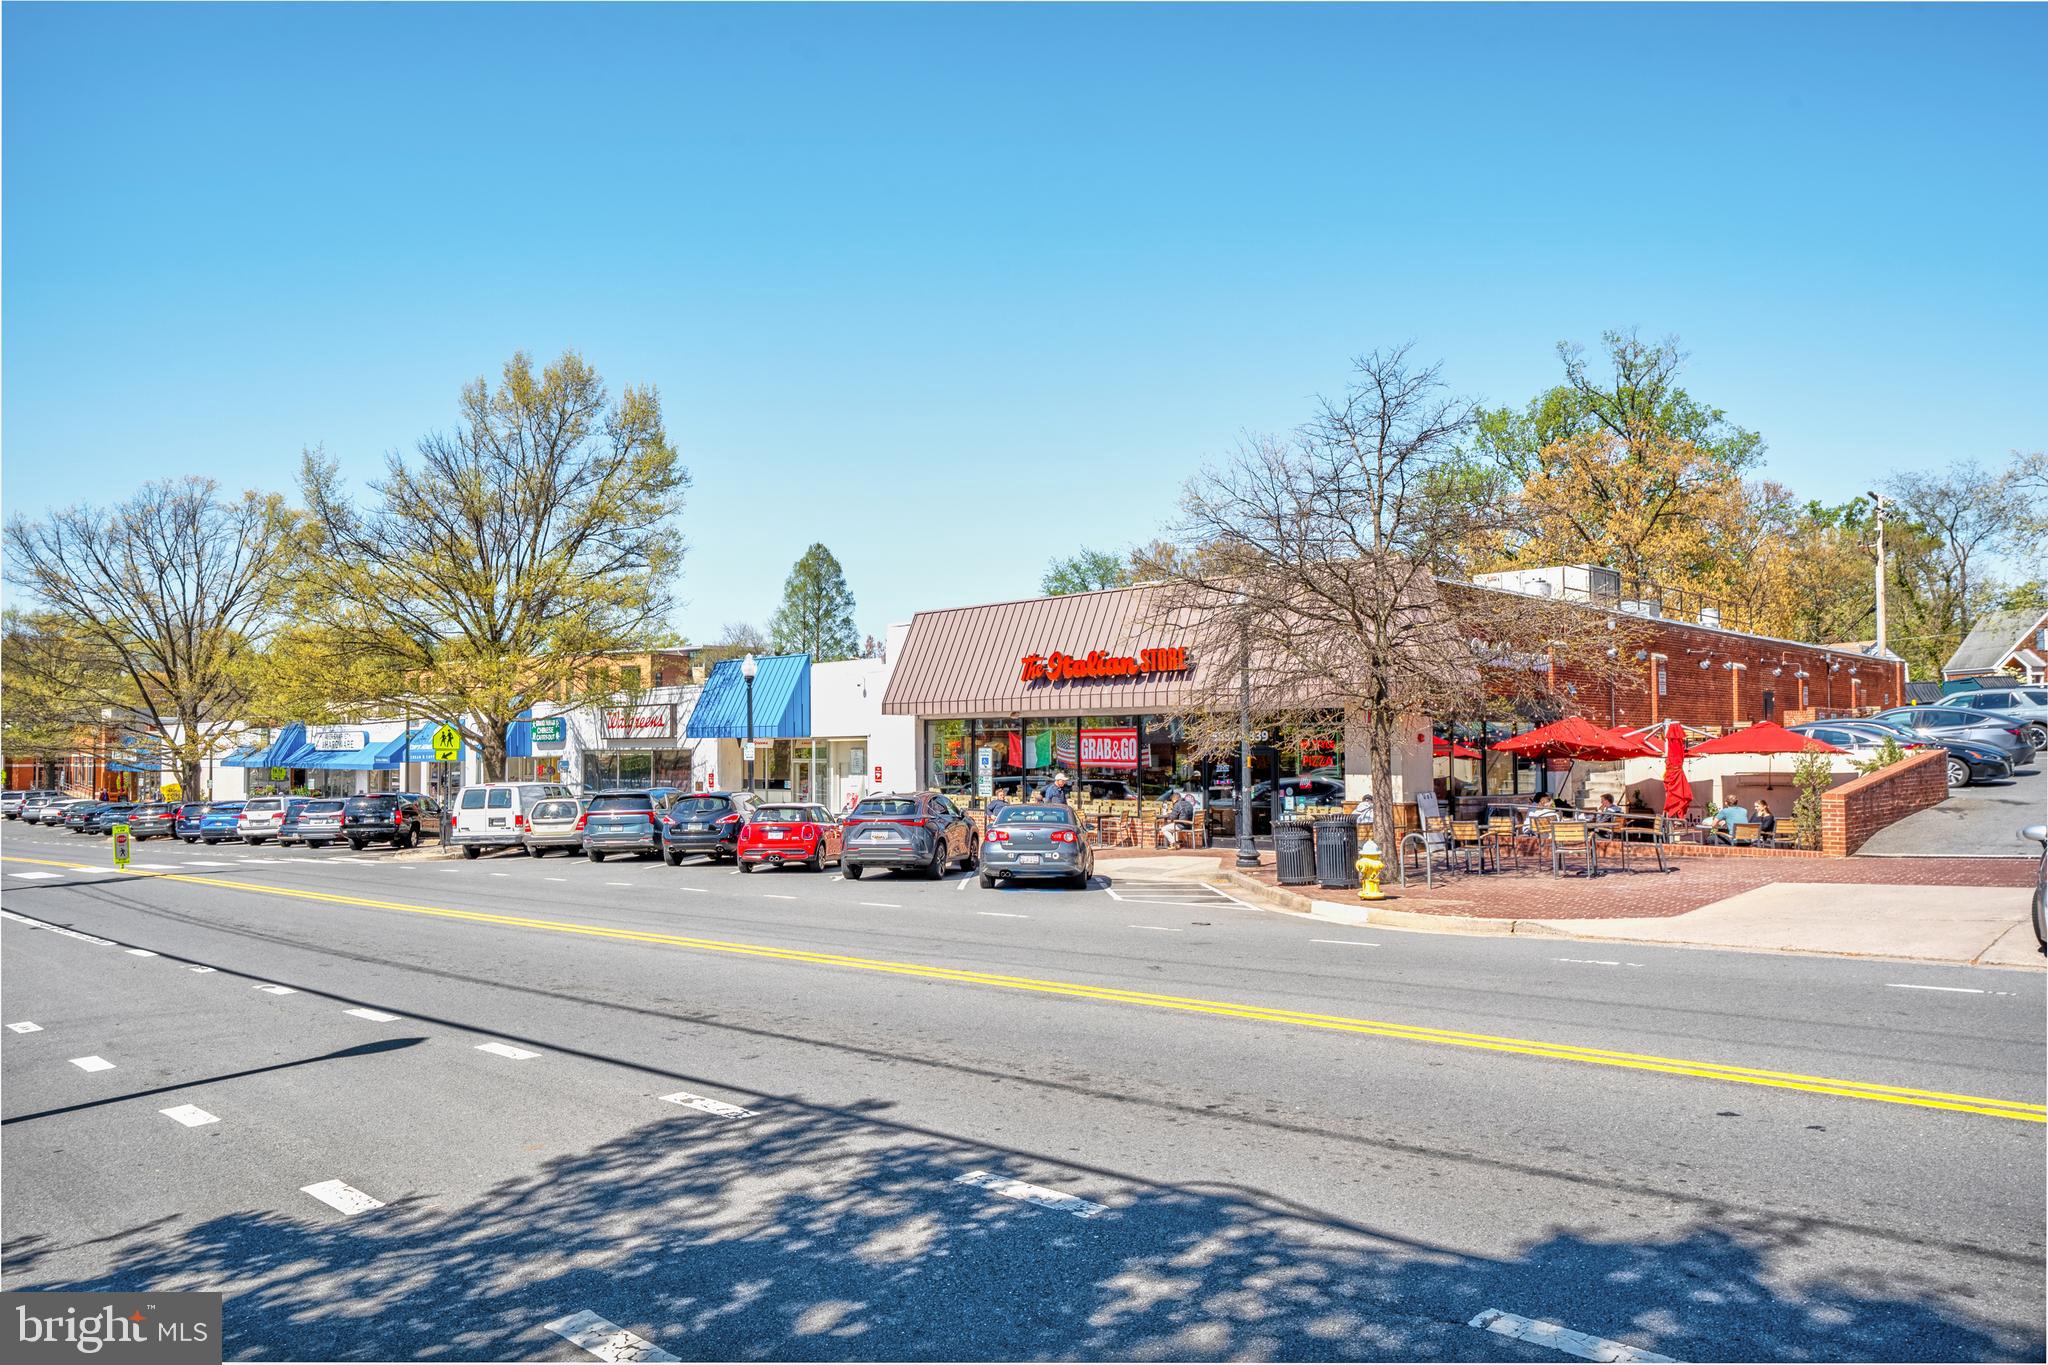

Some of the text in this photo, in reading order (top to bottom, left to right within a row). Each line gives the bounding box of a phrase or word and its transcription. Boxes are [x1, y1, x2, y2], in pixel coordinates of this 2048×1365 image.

[1021, 646, 1187, 681] The Italian STORE
[607, 709, 665, 735] Walgreens
[1081, 738, 1137, 760] GRAB&GO
[1303, 755, 1334, 767] PIZZA
